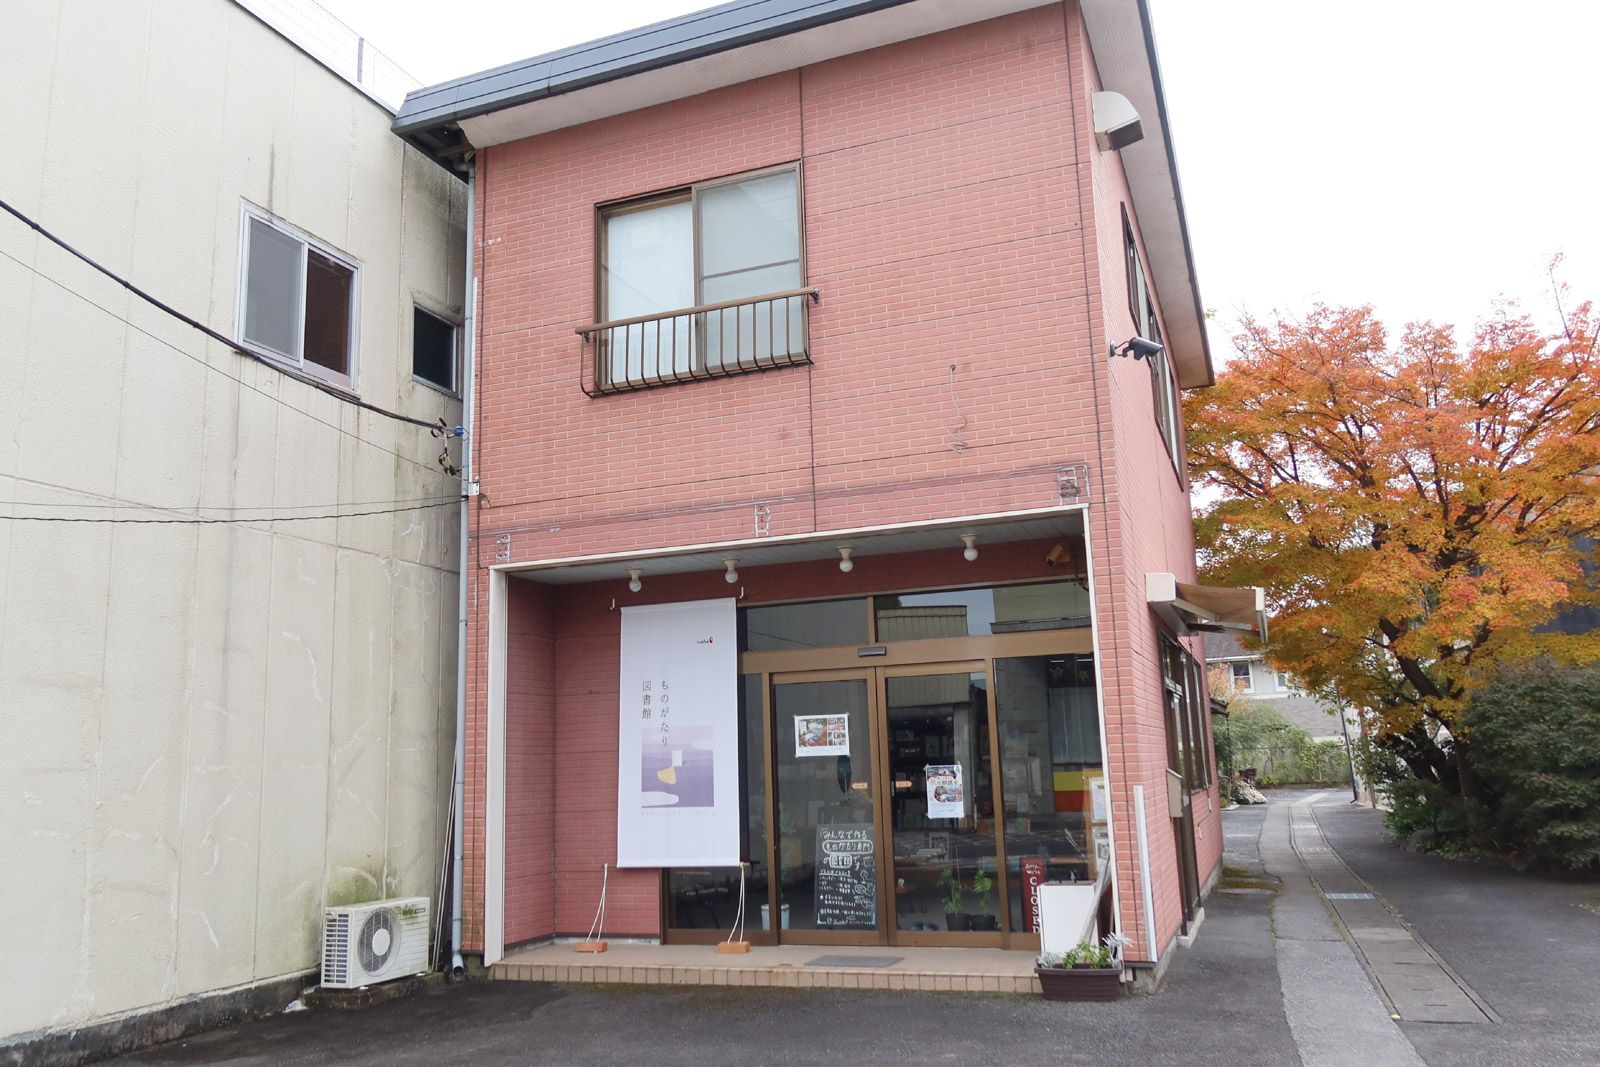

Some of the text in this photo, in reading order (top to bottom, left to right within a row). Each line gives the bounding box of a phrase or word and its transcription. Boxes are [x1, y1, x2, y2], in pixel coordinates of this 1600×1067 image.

[642, 680, 652, 719] 図書館
[660, 680, 670, 746] ものがたり
[1029, 876, 1040, 934] CLOSED
